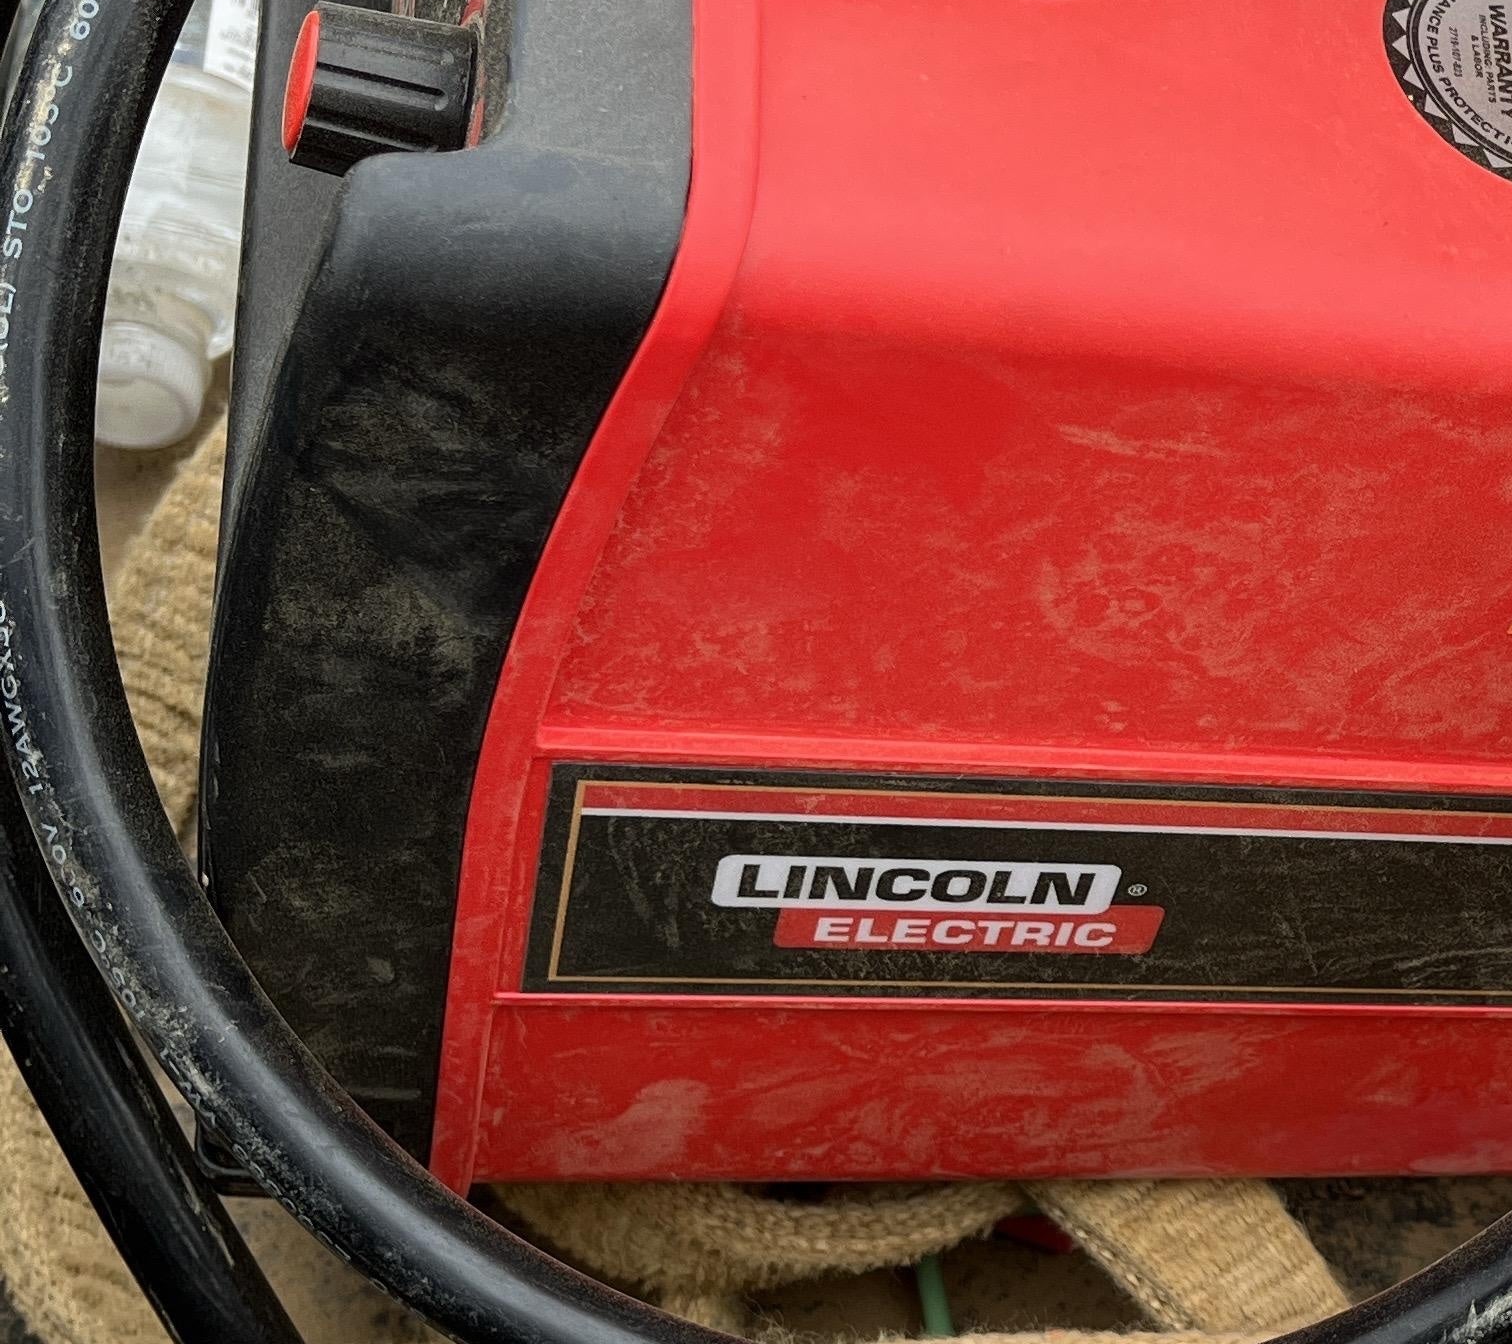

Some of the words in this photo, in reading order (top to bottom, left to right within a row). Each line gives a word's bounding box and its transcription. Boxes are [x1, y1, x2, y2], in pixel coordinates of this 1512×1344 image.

[1425, 35, 1445, 75] PLUS
[1472, 43, 1484, 79] LABOR
[1485, 70, 1497, 104] PARTS
[3, 188, 34, 260] STO
[737, 863, 1097, 906] LINCOLN
[812, 916, 1118, 948] ELECTRIC
